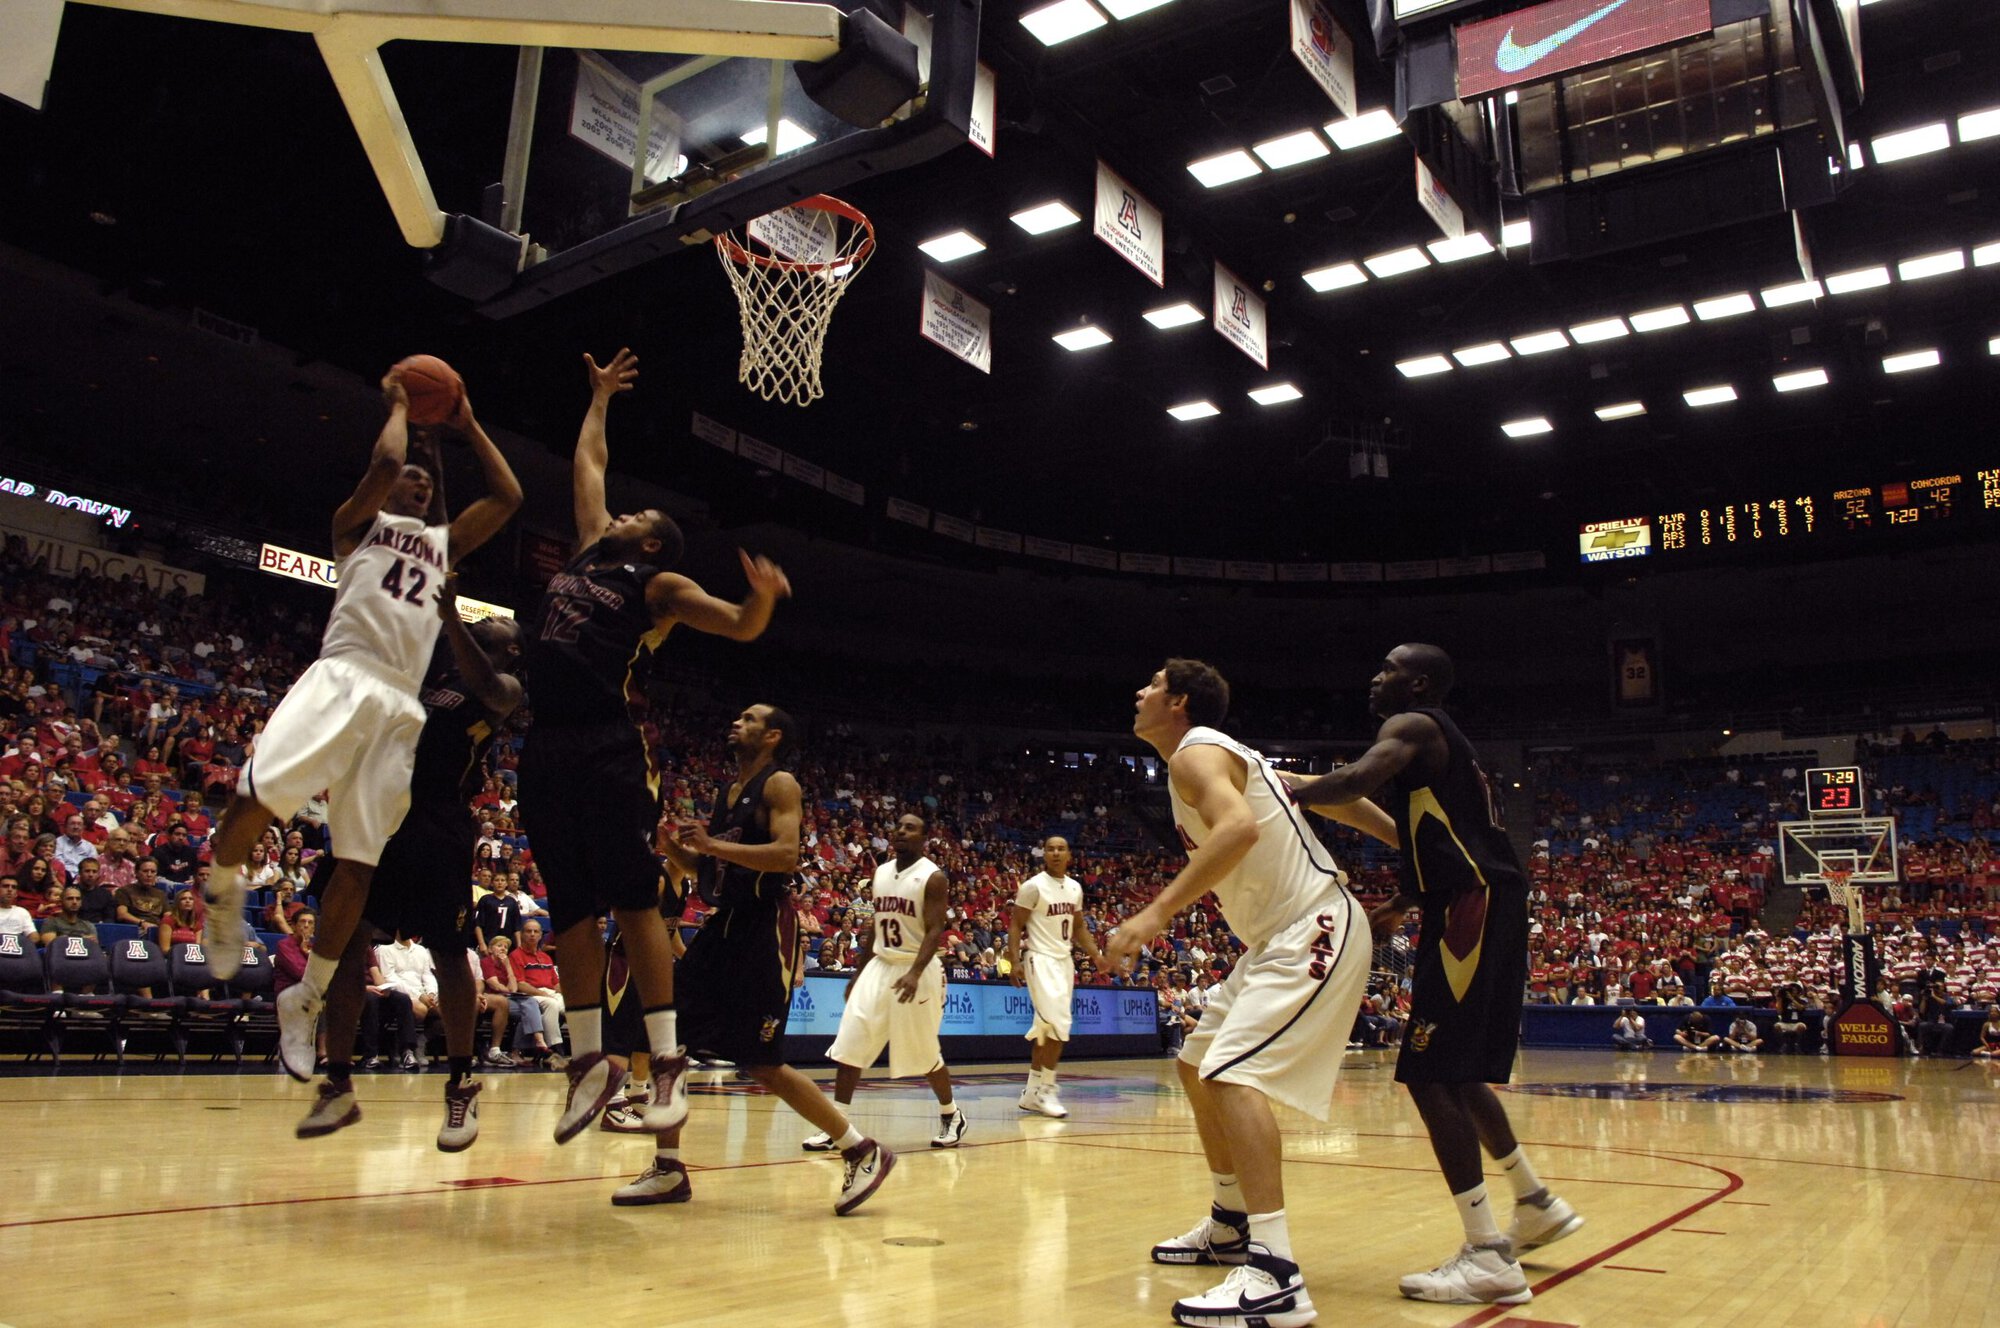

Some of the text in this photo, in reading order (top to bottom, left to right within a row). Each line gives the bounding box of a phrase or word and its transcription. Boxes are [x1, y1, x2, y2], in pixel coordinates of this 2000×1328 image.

[1117, 189, 1142, 241] A
[1231, 285, 1251, 330] A
[1911, 474, 1962, 490] CONCORDIA
[1833, 487, 1872, 500] ARIZONA
[1930, 488, 1950, 502] 42
[1658, 496, 1813, 524] PLYR 0 5 13 42 44
[1846, 499, 1865, 514] 52
[1585, 517, 1643, 533] O'RIELLY
[1663, 521, 1683, 532] PTS
[1804, 505, 1813, 514] 0
[1886, 508, 1919, 525] 7:29
[1662, 530, 1685, 541] RBS
[1702, 535, 1711, 545] 0
[1727, 532, 1736, 542] 0
[1753, 529, 1762, 538] 0
[1779, 526, 1788, 536] 0
[1587, 546, 1646, 562] WATSON
[262, 547, 328, 585] BEAR
[381, 557, 426, 607] 42
[540, 596, 595, 644] 12
[1625, 666, 1646, 680] 32
[1822, 771, 1855, 785] 7:29
[1821, 786, 1851, 809] 23
[497, 906, 509, 929] 7
[880, 918, 903, 948] 13
[1061, 919, 1069, 941] 0
[1308, 913, 1336, 981] CATS
[1851, 938, 1867, 999] ARIZONA
[1004, 996, 1028, 1015] UPH
[1124, 999, 1143, 1016] UPH
[1839, 1022, 1888, 1033] WELLS
[1841, 1033, 1888, 1045] FARGO
